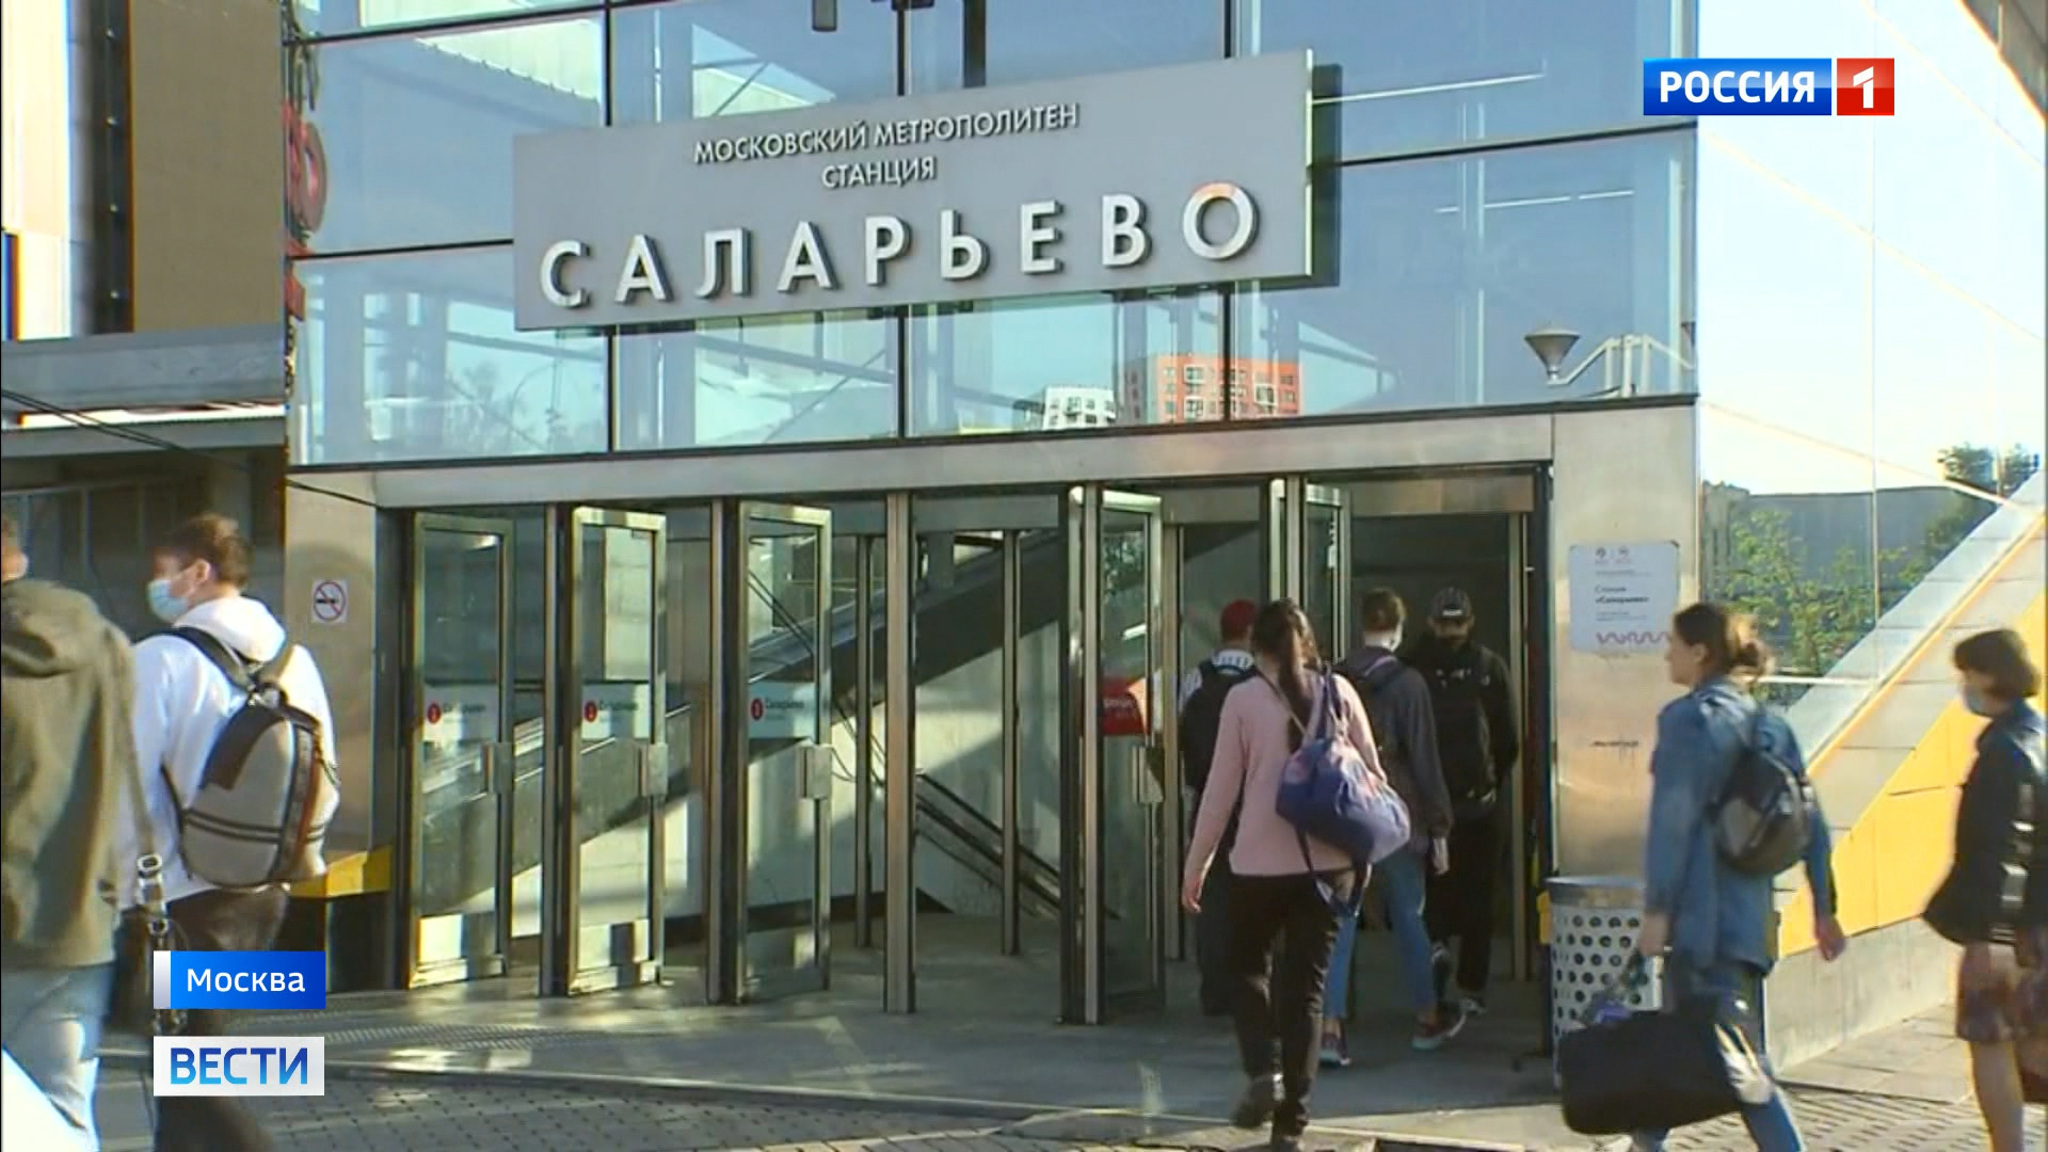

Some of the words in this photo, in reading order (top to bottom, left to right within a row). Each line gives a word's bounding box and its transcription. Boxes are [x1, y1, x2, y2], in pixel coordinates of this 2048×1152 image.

[694, 120, 869, 164] МОСКОВСКИЙ
[874, 102, 1080, 148] МЕТРОПОЛИТЕН
[822, 156, 937, 189] СТАНЦИЯ
[540, 182, 1259, 308] САЛАРЬЕВО
